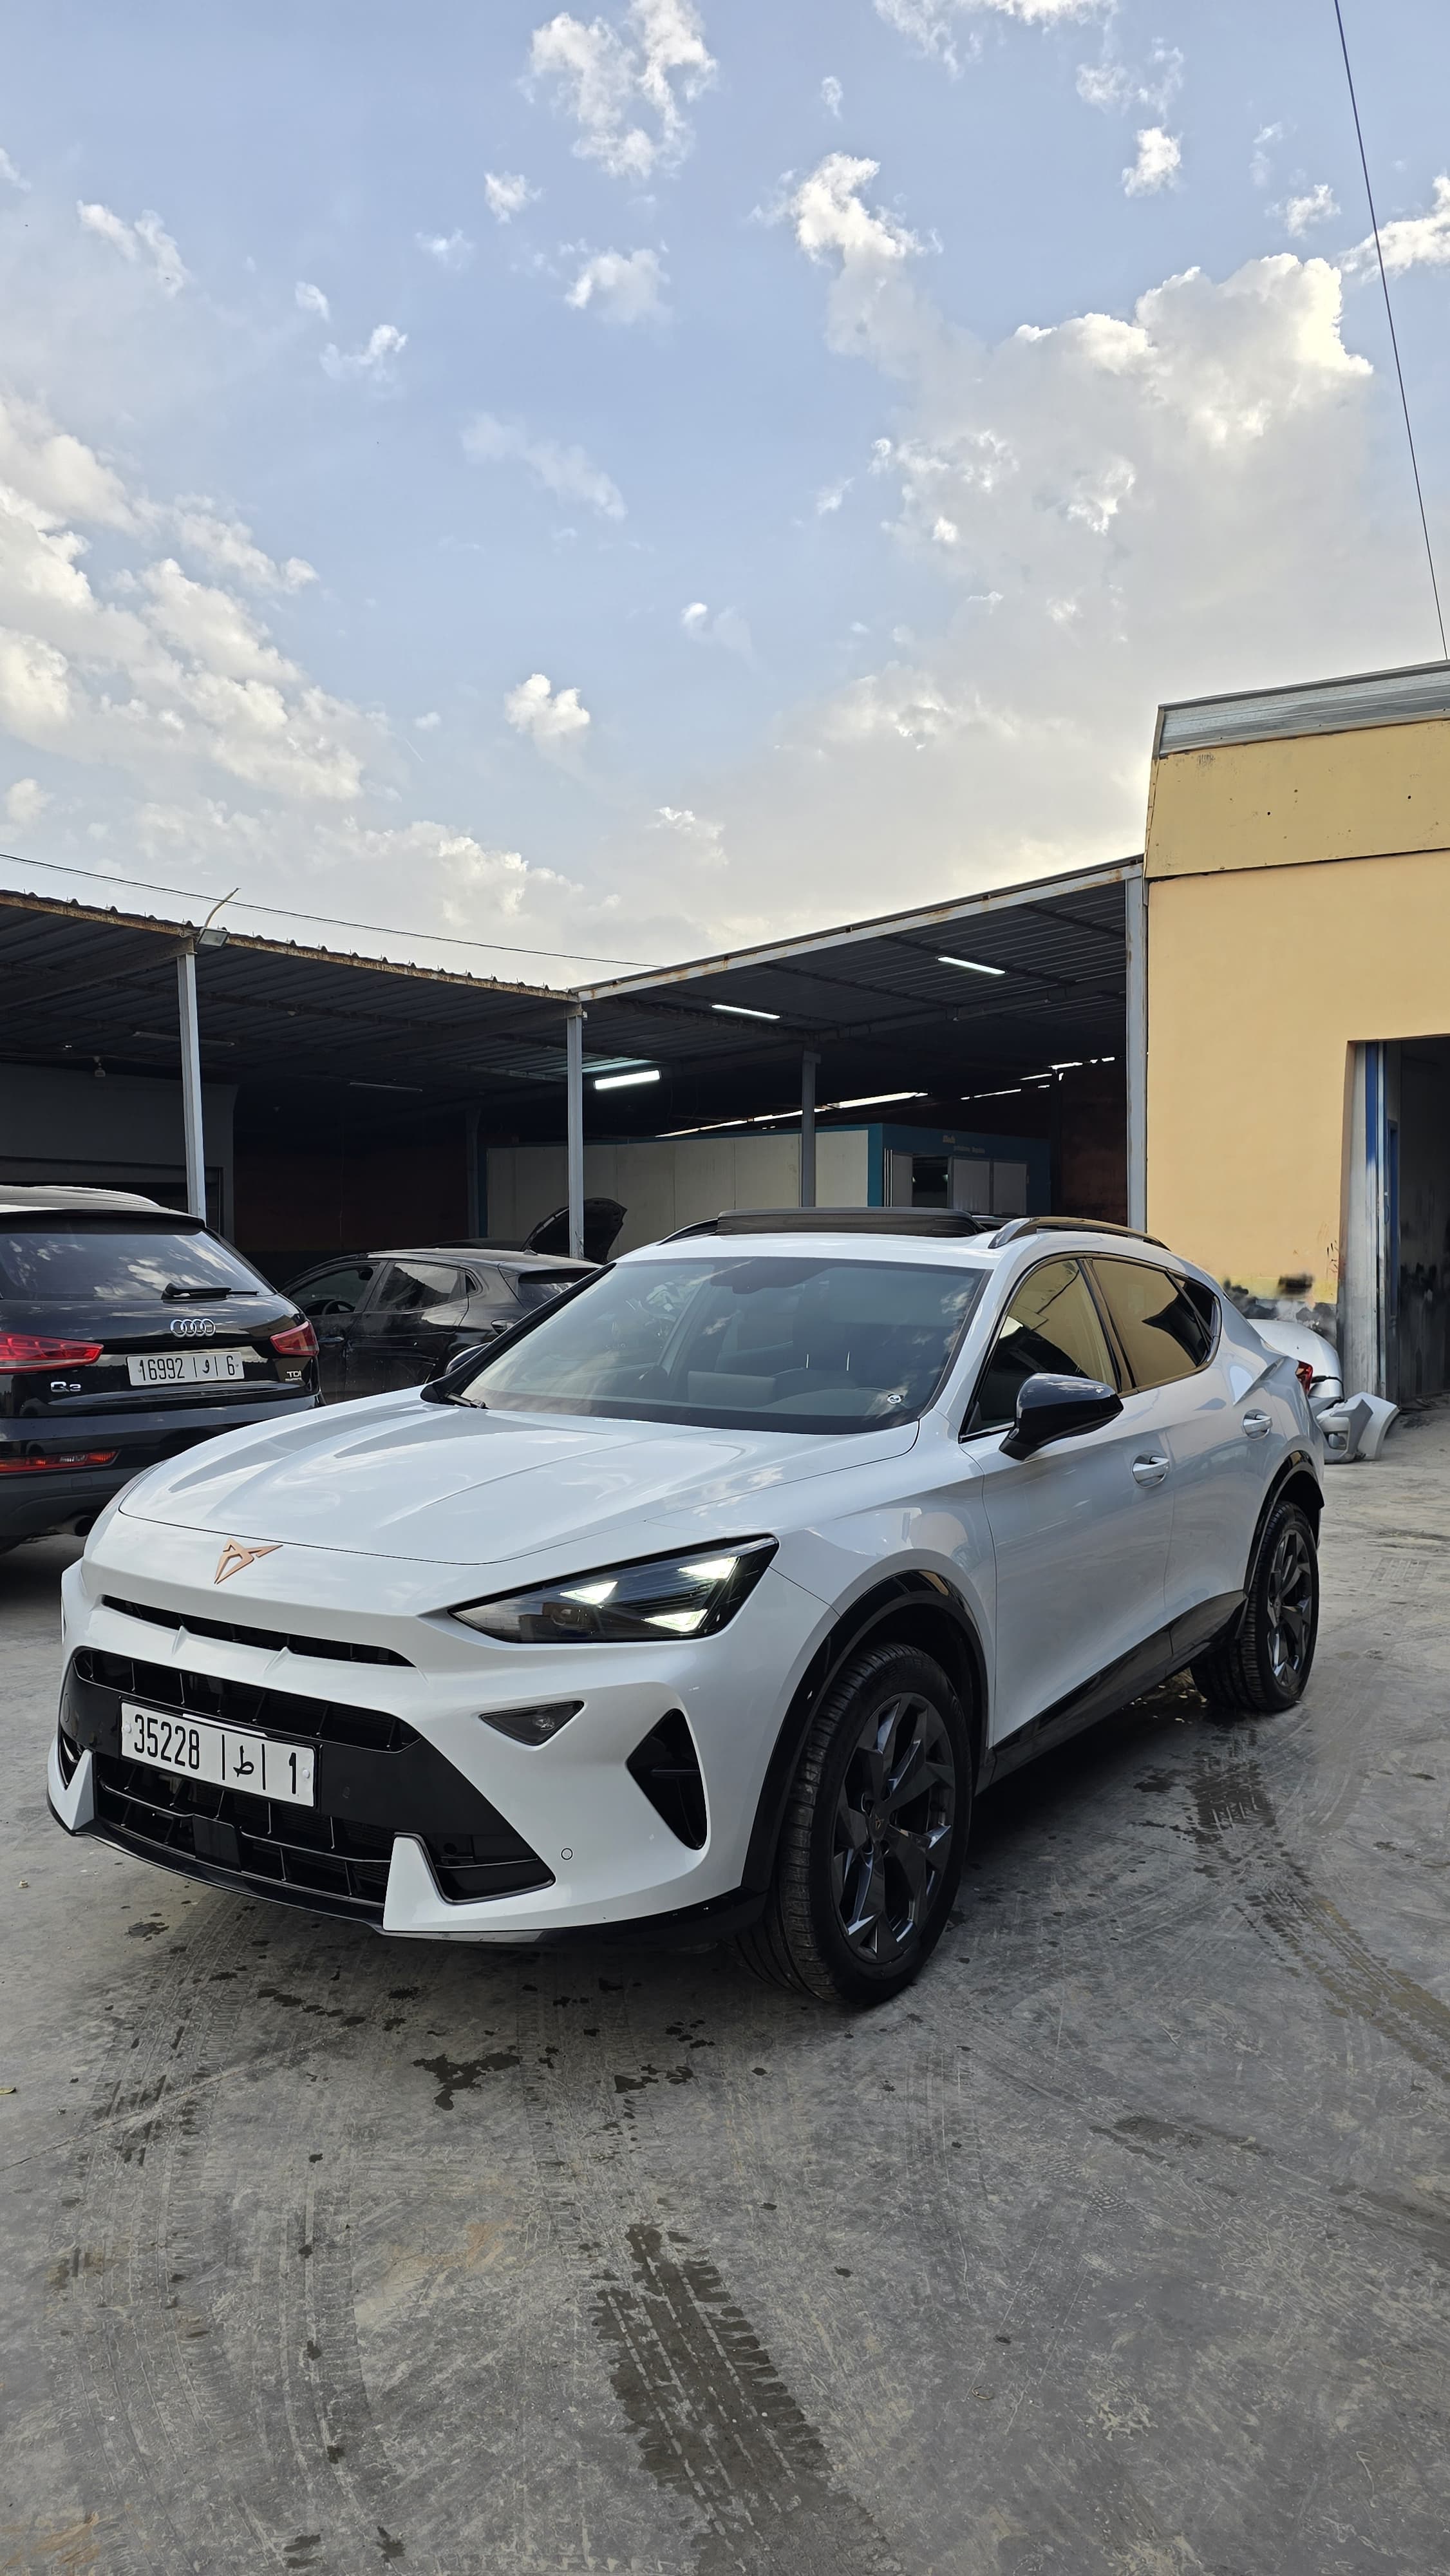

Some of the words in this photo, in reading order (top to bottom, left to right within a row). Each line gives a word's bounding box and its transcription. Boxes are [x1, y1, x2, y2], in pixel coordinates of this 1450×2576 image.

[140, 1358, 185, 1381] 16992
[202, 1359, 210, 1374] و
[227, 1355, 235, 1376] 6
[50, 1381, 82, 1392] Q3
[134, 1714, 200, 1770] 35228
[233, 1745, 254, 1777] ط
[288, 1752, 296, 1794] 1
